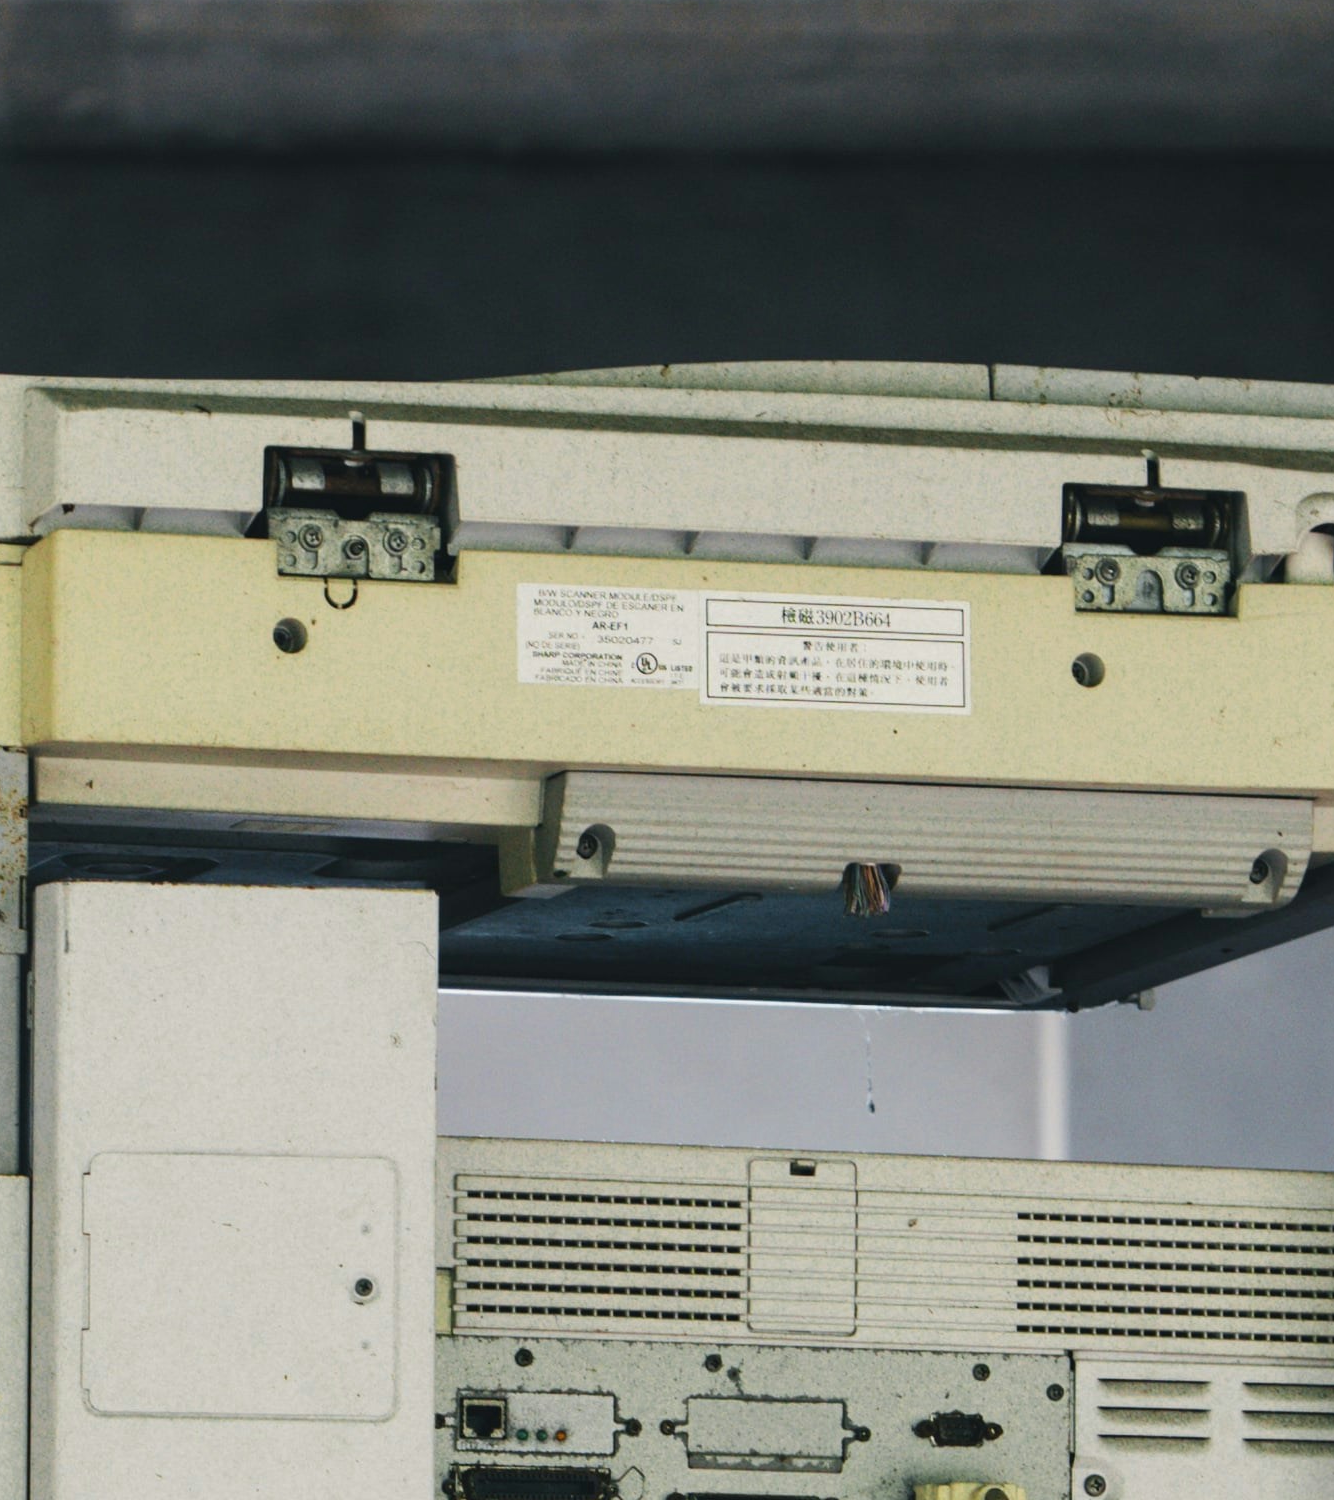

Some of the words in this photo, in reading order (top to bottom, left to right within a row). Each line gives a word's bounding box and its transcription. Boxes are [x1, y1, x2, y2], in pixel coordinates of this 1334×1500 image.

[560, 590, 606, 600] SCANNER
[606, 600, 618, 609] DE
[622, 601, 668, 611] ESCANER
[671, 602, 684, 612] EN
[534, 608, 572, 617] BLANCO
[575, 609, 581, 617] Y
[584, 610, 619, 619] NEGRO
[592, 621, 629, 631] AR-EF1
[597, 635, 654, 645] 35020477
[532, 650, 559, 659] SHARP
[563, 651, 623, 661] CORPORATION
[562, 658, 583, 667] MADE
[588, 659, 595, 667] IN
[599, 660, 622, 668] CHINA
[670, 664, 693, 672] LISTED
[540, 666, 581, 675] FABRIQUE
[584, 668, 596, 676] EN
[599, 668, 622, 676] CHINE
[535, 674, 582, 683] FABRICADO
[585, 676, 596, 684] EN
[599, 676, 623, 684] CHINA
